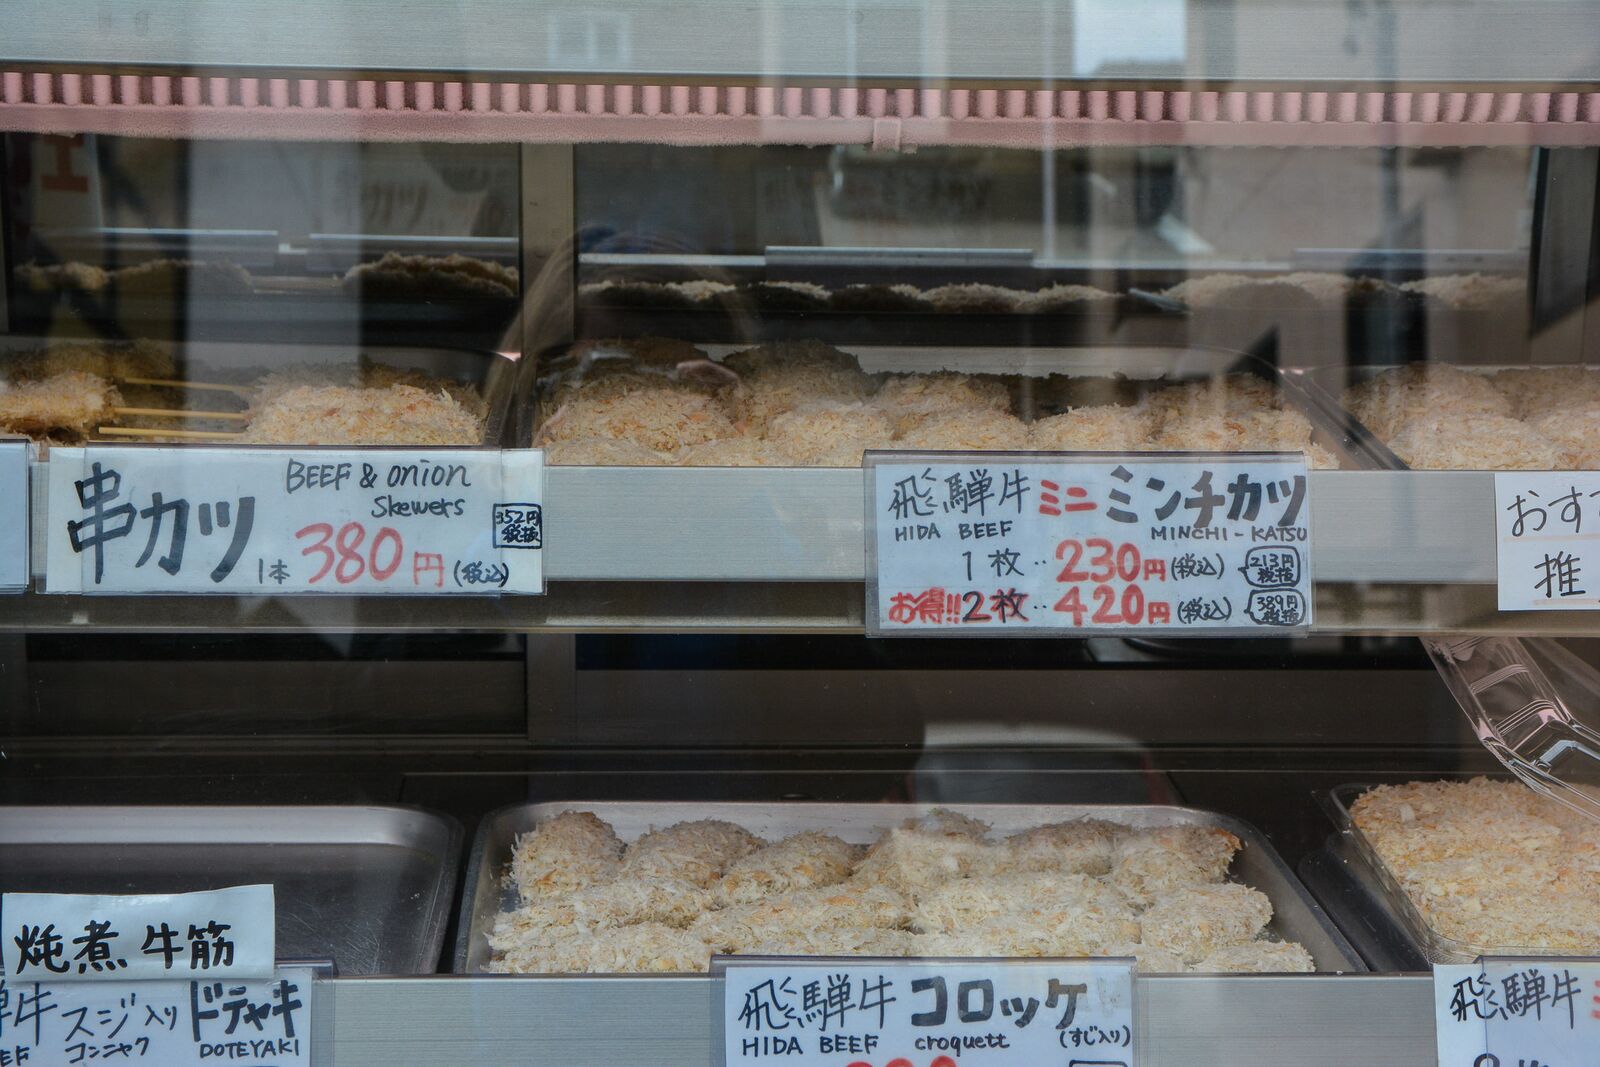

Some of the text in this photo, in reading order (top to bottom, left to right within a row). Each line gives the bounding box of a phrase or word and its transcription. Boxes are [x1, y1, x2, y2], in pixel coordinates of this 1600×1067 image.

[286, 458, 472, 494] BEEF & onion
[371, 495, 466, 518] Skewers
[1106, 464, 1307, 528] ミンチカツ
[1506, 485, 1600, 537] おす
[67, 461, 255, 584] 串カツ
[895, 522, 941, 541] HIDA
[958, 520, 1013, 540] BEEF
[738, 973, 1088, 1031] 飛騨牛 コロッケ
[199, 1038, 300, 1060] DOTEYAKI
[742, 1033, 804, 1057] HIDA
[819, 1034, 879, 1055] BEEF
